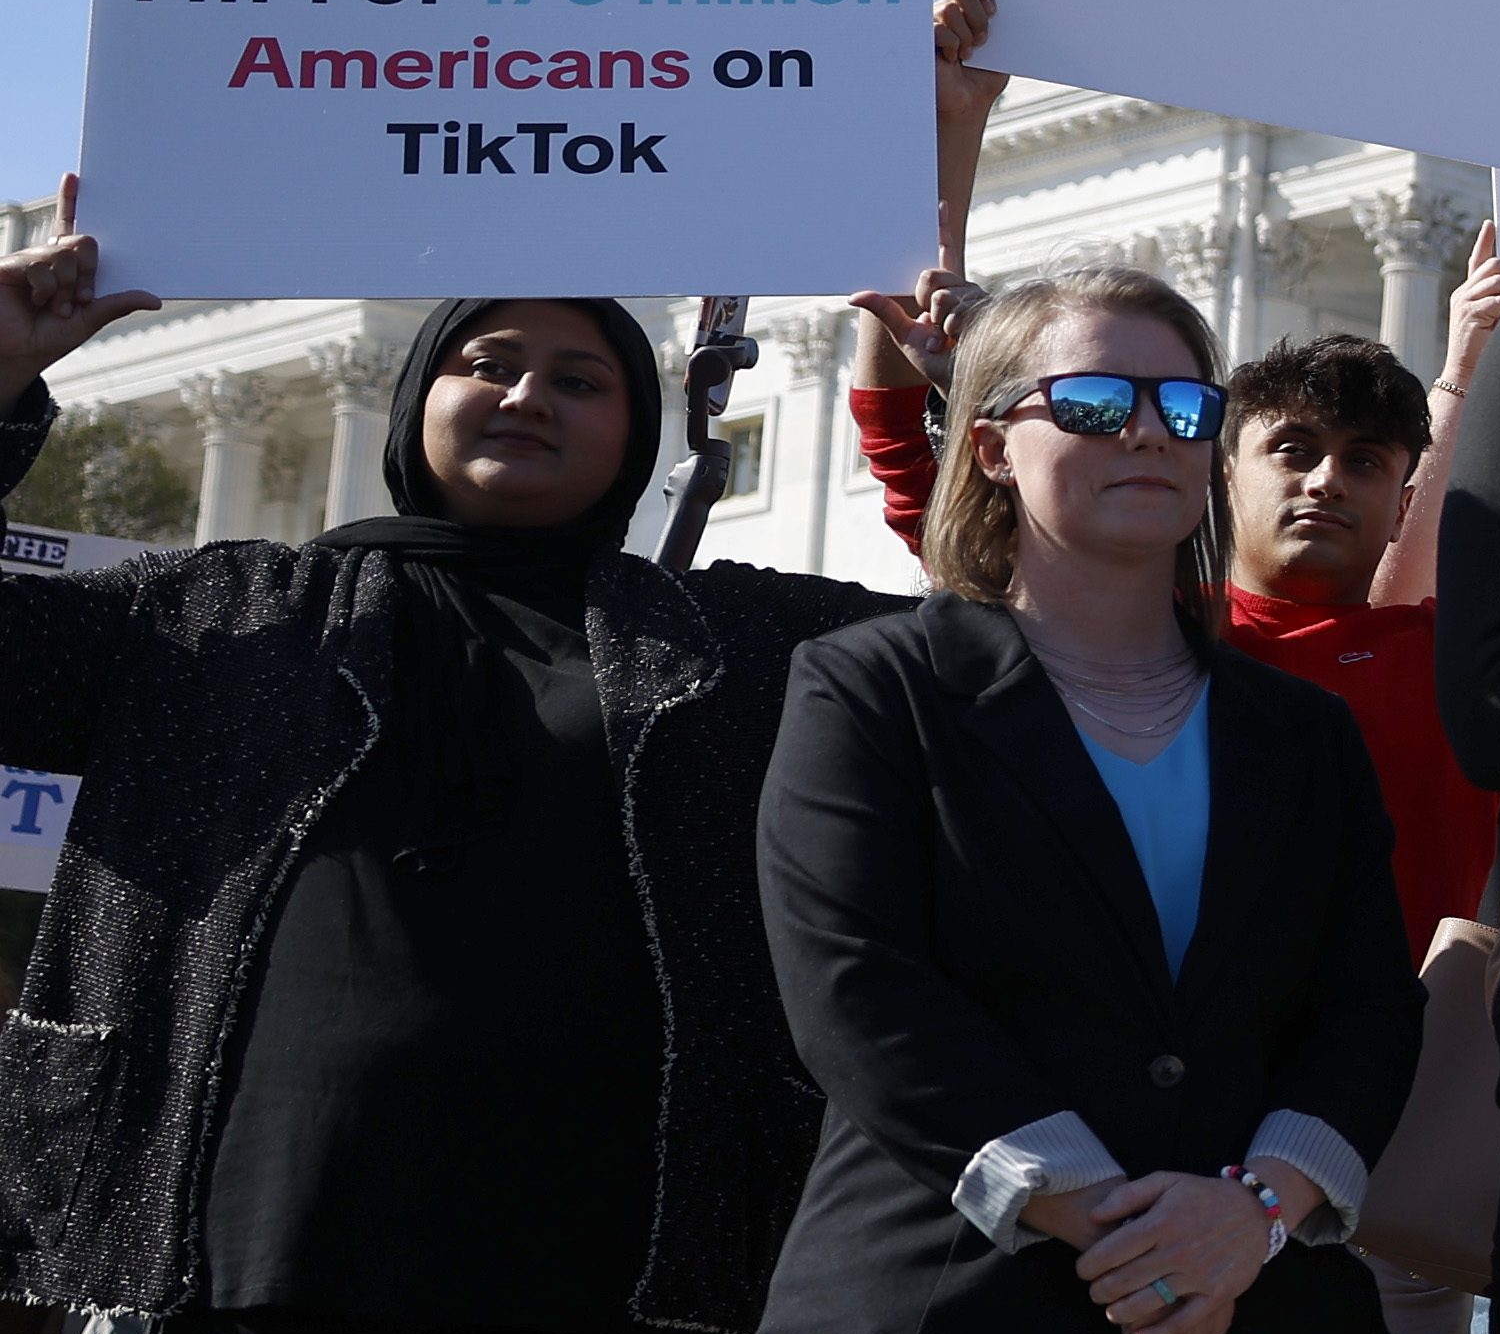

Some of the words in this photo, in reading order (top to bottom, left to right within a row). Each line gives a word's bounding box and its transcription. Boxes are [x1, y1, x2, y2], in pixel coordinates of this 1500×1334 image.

[228, 36, 690, 89] Americans
[713, 50, 813, 88] on
[387, 121, 667, 174] TikTok
